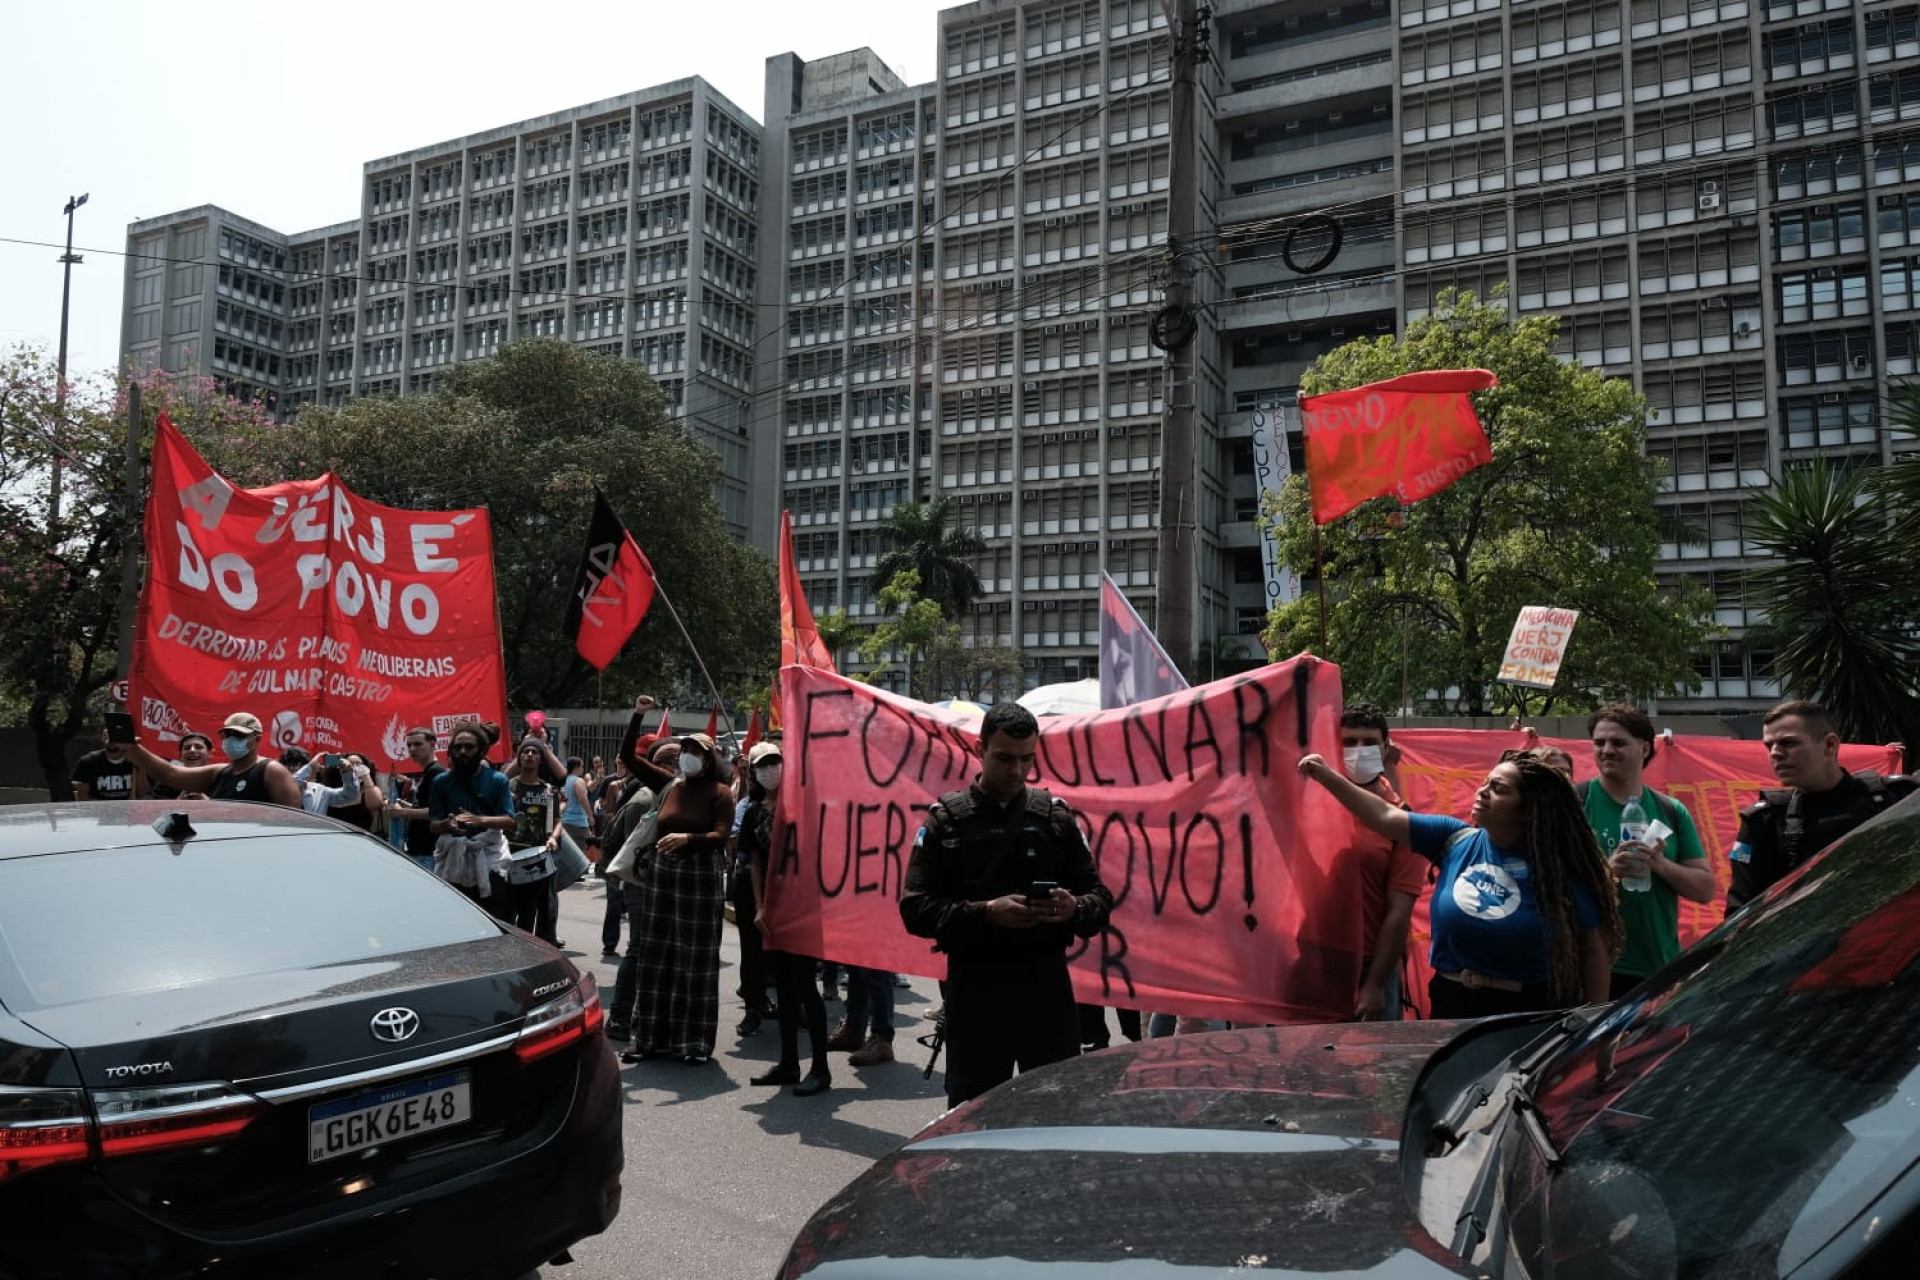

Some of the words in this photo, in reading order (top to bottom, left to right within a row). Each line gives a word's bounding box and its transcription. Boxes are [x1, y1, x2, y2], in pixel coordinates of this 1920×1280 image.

[179, 474, 233, 530] A
[410, 514, 476, 572] É
[176, 520, 258, 611] DO
[296, 553, 439, 635] POVO
[158, 613, 267, 661] DERROTAR
[357, 649, 456, 677] NEOLIBERAIS
[1510, 646, 1561, 666] CONTRA
[1515, 629, 1567, 646] UERJ
[219, 670, 247, 693] DE
[247, 668, 323, 693] GULNAR
[330, 673, 392, 702] CASTRO
[1503, 662, 1557, 681] FOME
[1026, 663, 1308, 786] ULNAR!
[778, 821, 798, 876] A
[1476, 880, 1505, 897] UNE
[105, 1061, 173, 1078] TOYOTA
[327, 1091, 455, 1153] GGK6E48
